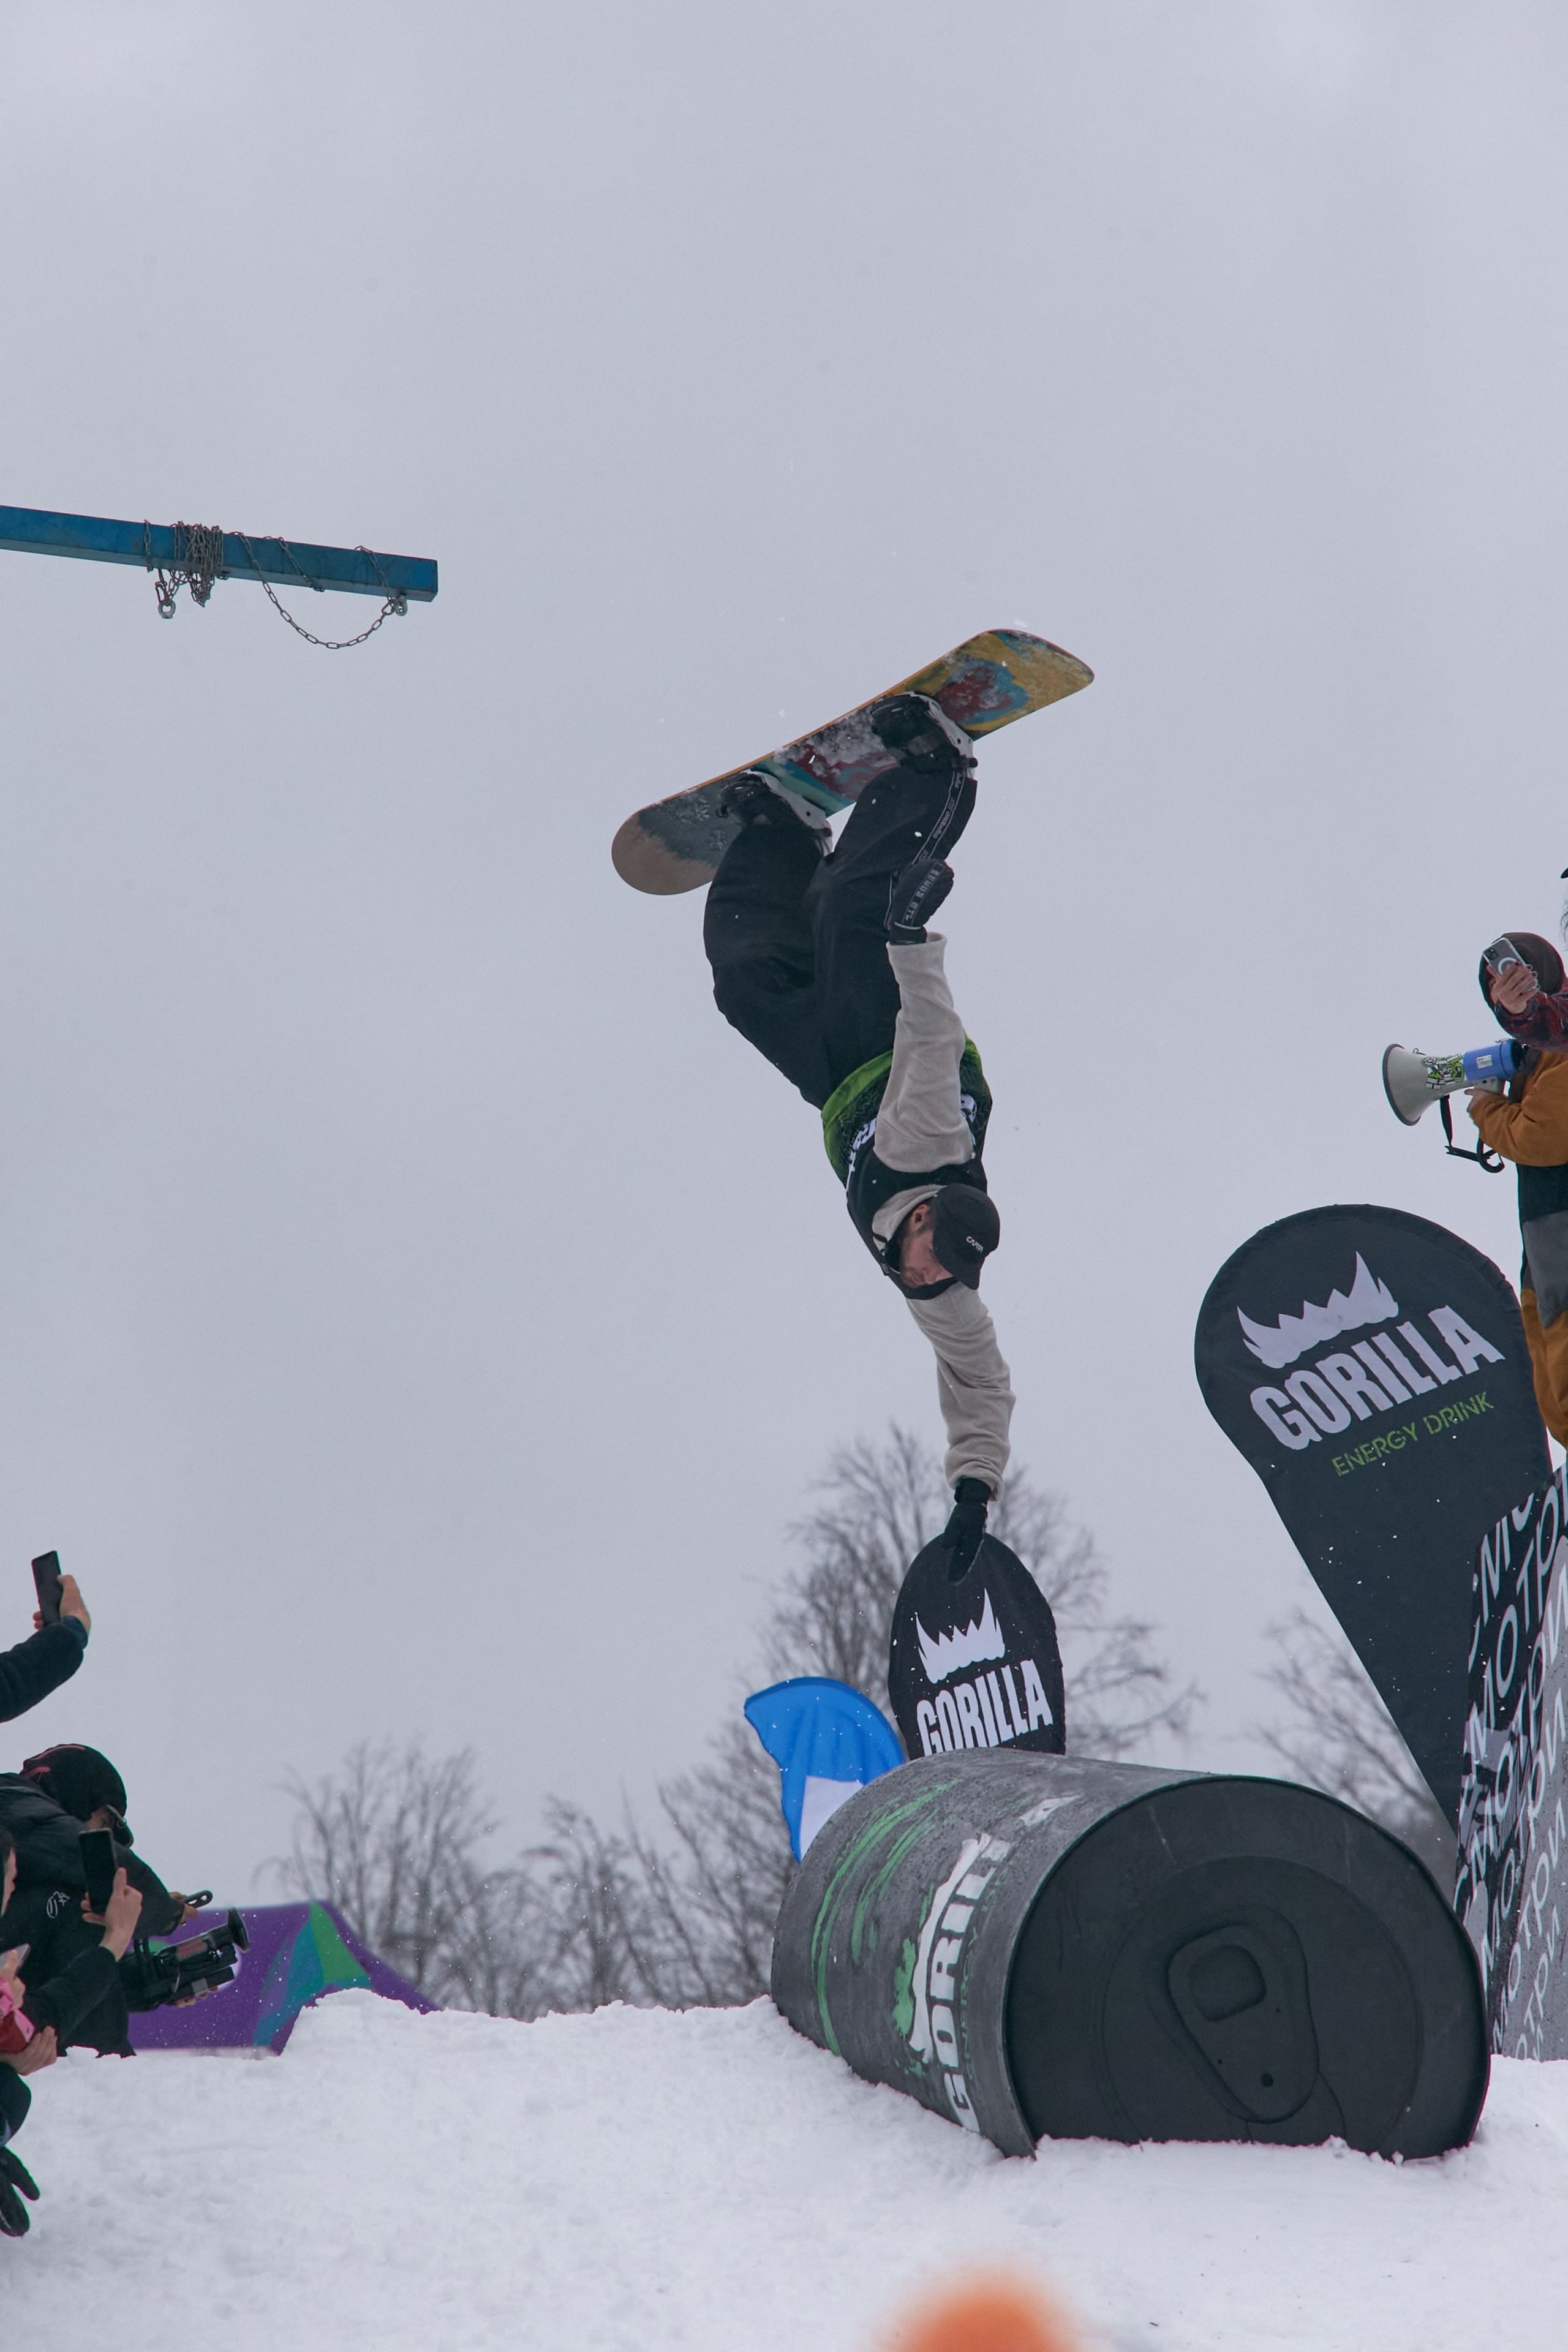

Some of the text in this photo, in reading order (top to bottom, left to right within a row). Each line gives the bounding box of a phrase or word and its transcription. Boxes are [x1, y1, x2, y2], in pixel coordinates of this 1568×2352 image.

[1250, 1305, 1505, 1450] GORILLA
[1332, 1392, 1494, 1476] ENERGY DRINK
[917, 1659, 1054, 1757] GORILLA
